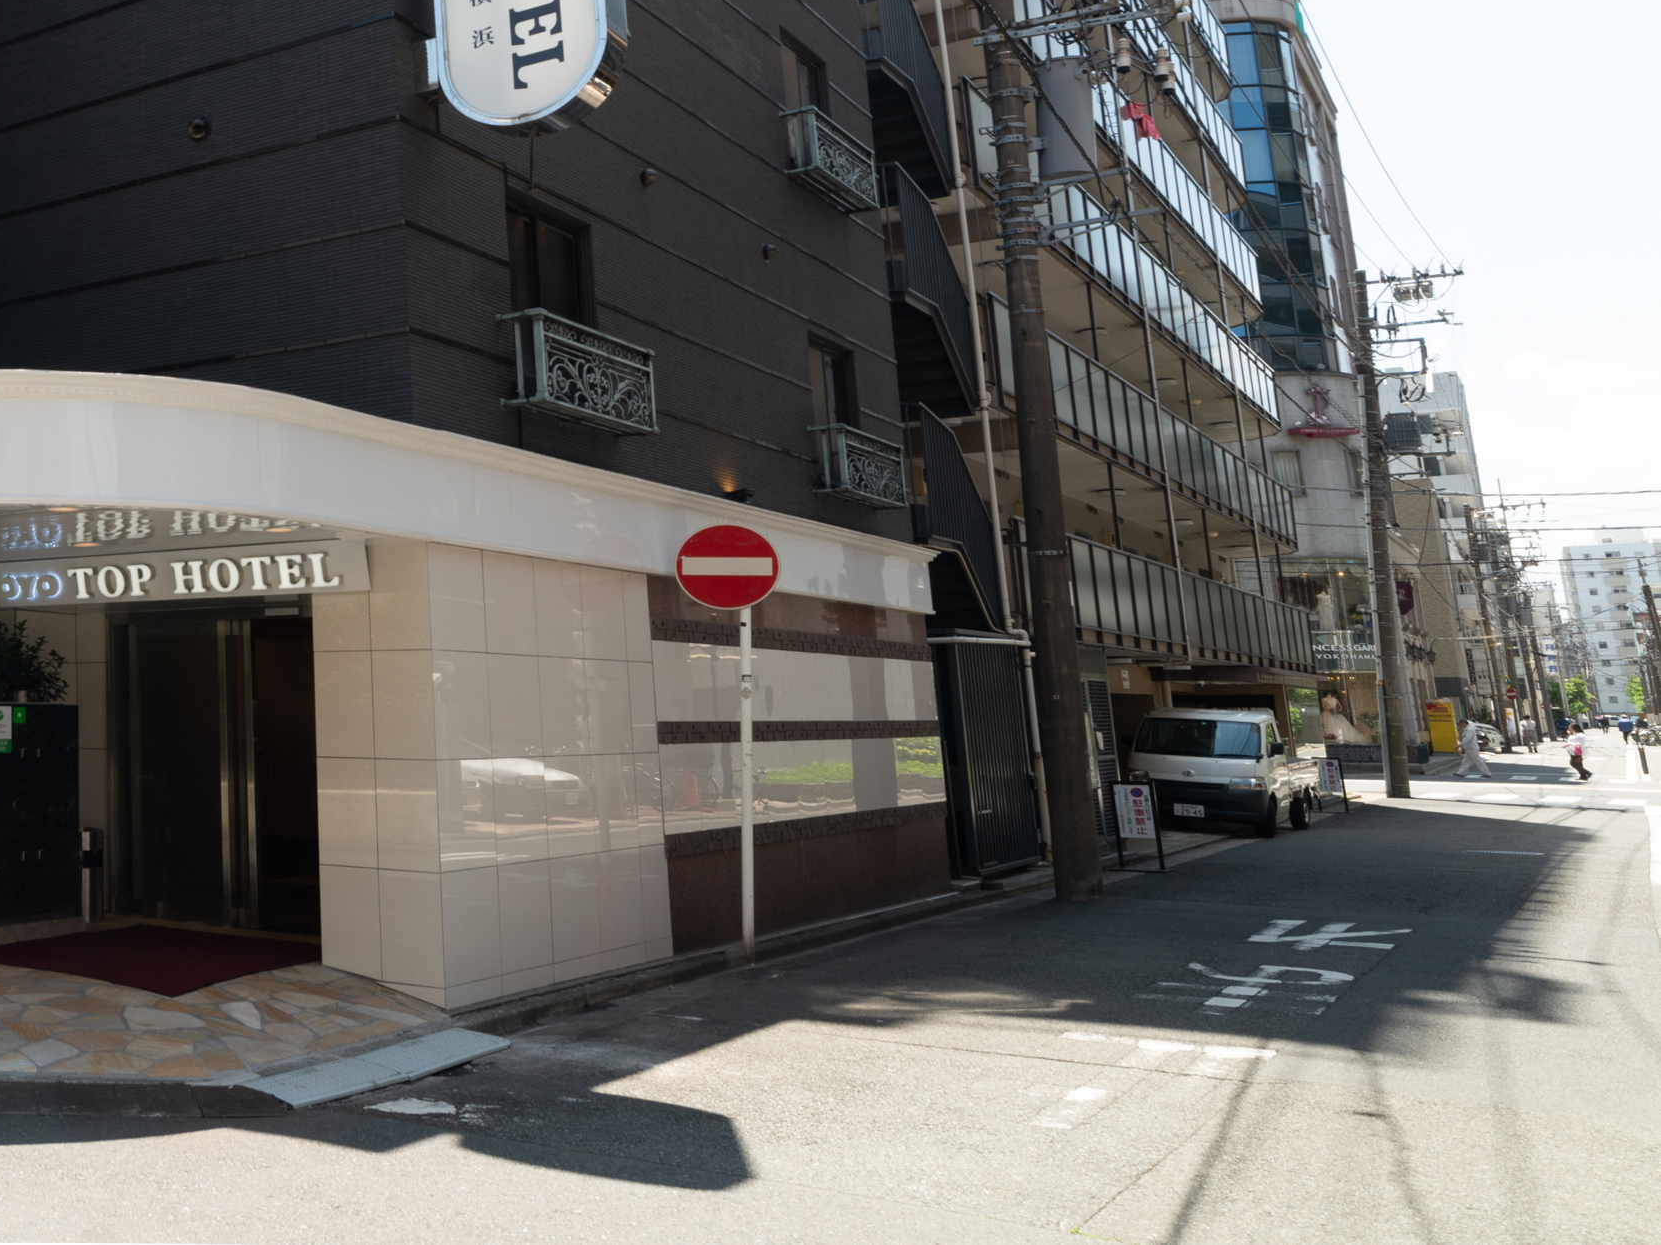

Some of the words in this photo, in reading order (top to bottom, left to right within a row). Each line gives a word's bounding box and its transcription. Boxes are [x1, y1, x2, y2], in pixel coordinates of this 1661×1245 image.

[67, 564, 154, 600] TOP
[171, 552, 342, 594] HOTEL
[1312, 644, 1376, 652] NCESSGAR
[1133, 799, 1147, 835] 駐車禁止
